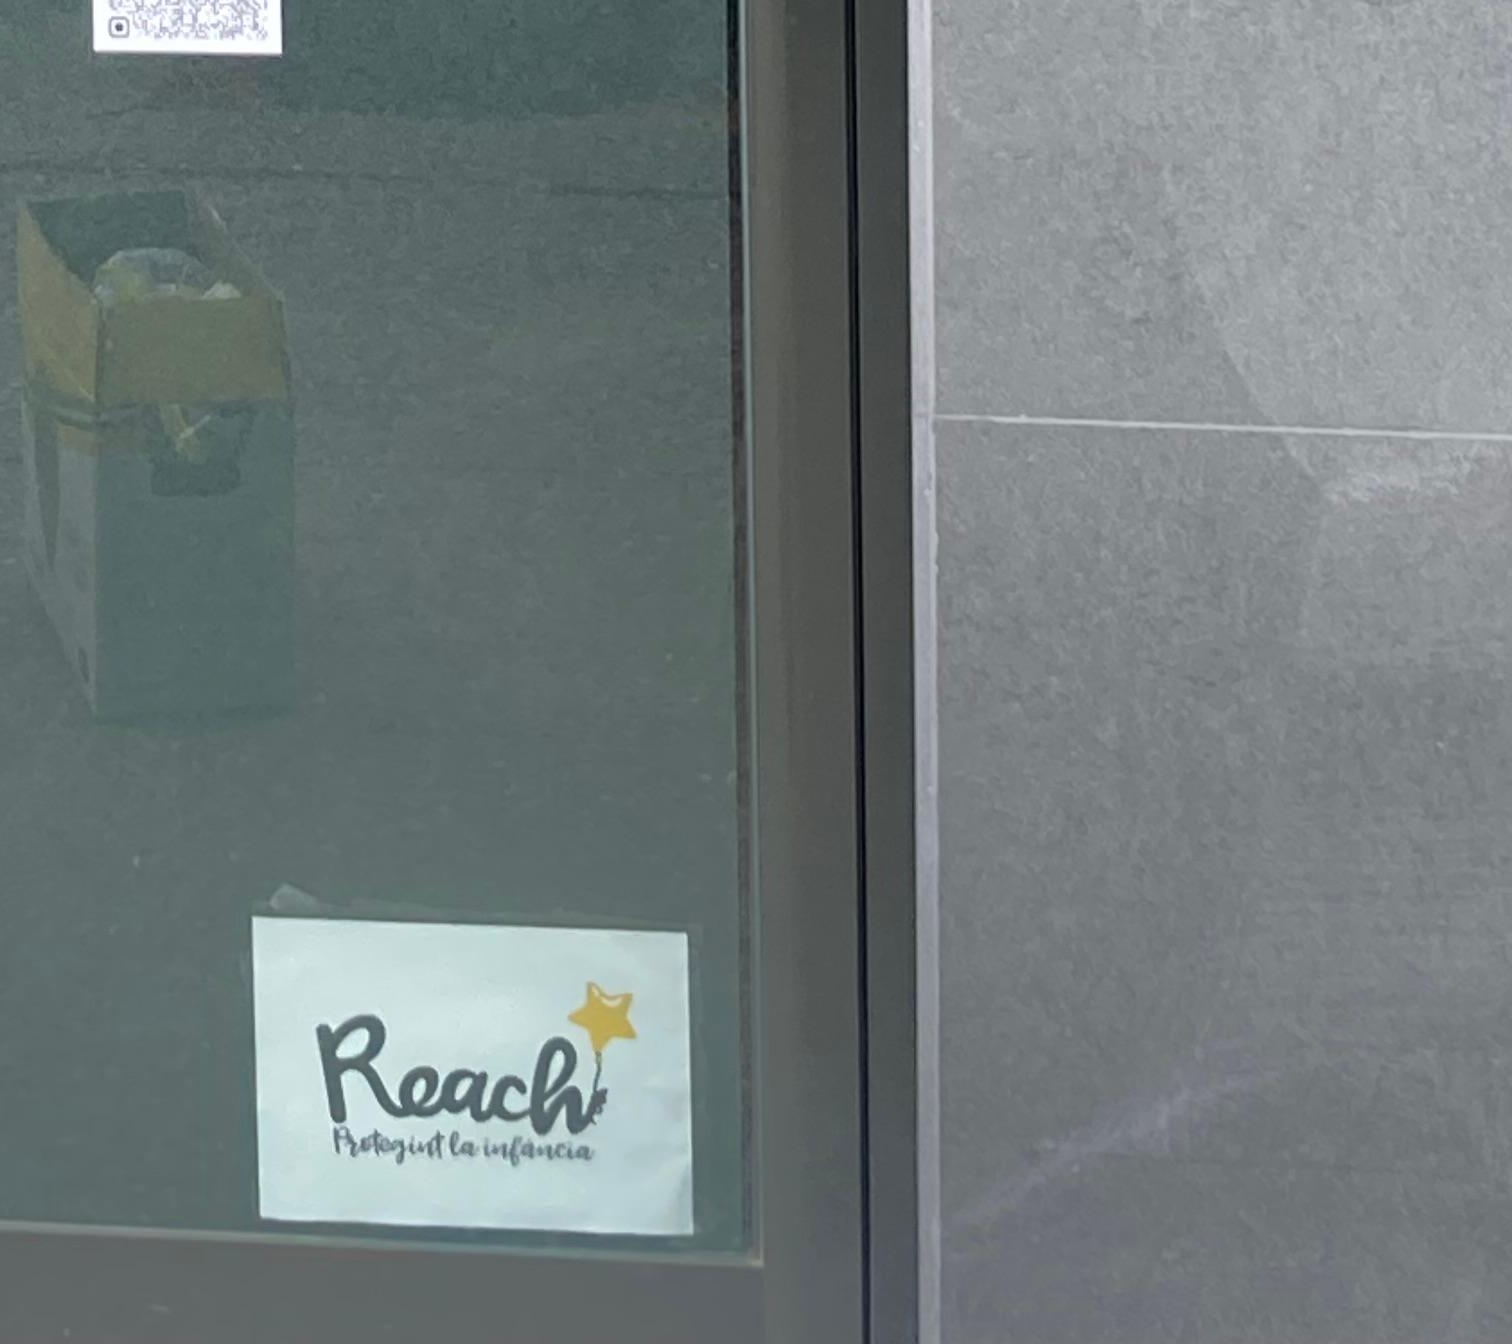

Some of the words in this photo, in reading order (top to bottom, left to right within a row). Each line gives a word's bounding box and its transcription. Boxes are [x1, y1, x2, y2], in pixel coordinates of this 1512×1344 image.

[316, 1014, 594, 1135] Reach
[333, 1126, 445, 1166] Protegint
[448, 1131, 478, 1158] la
